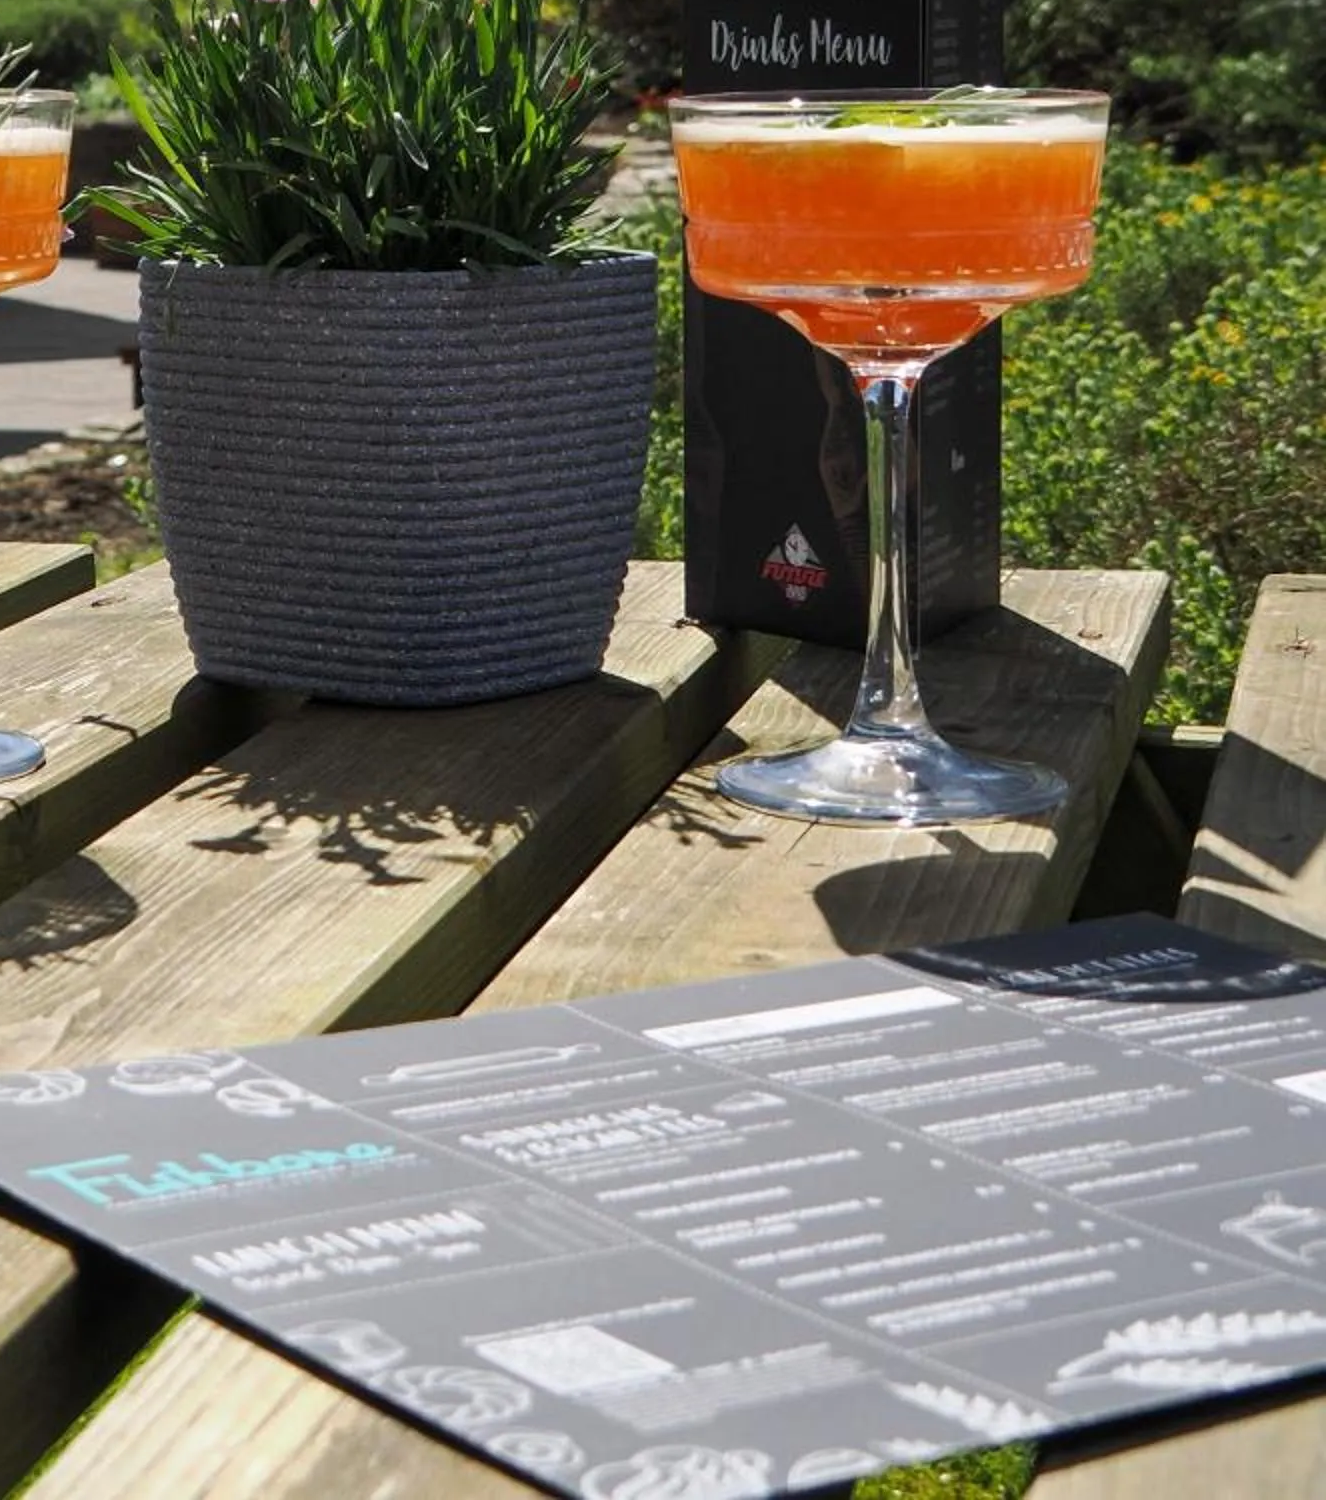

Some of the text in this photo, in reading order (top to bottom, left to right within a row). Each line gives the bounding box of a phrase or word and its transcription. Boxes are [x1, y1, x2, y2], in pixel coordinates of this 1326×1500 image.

[712, 14, 802, 71] Drinks
[811, 19, 890, 66] Menu
[27, 1142, 396, 1205] Fishbone
